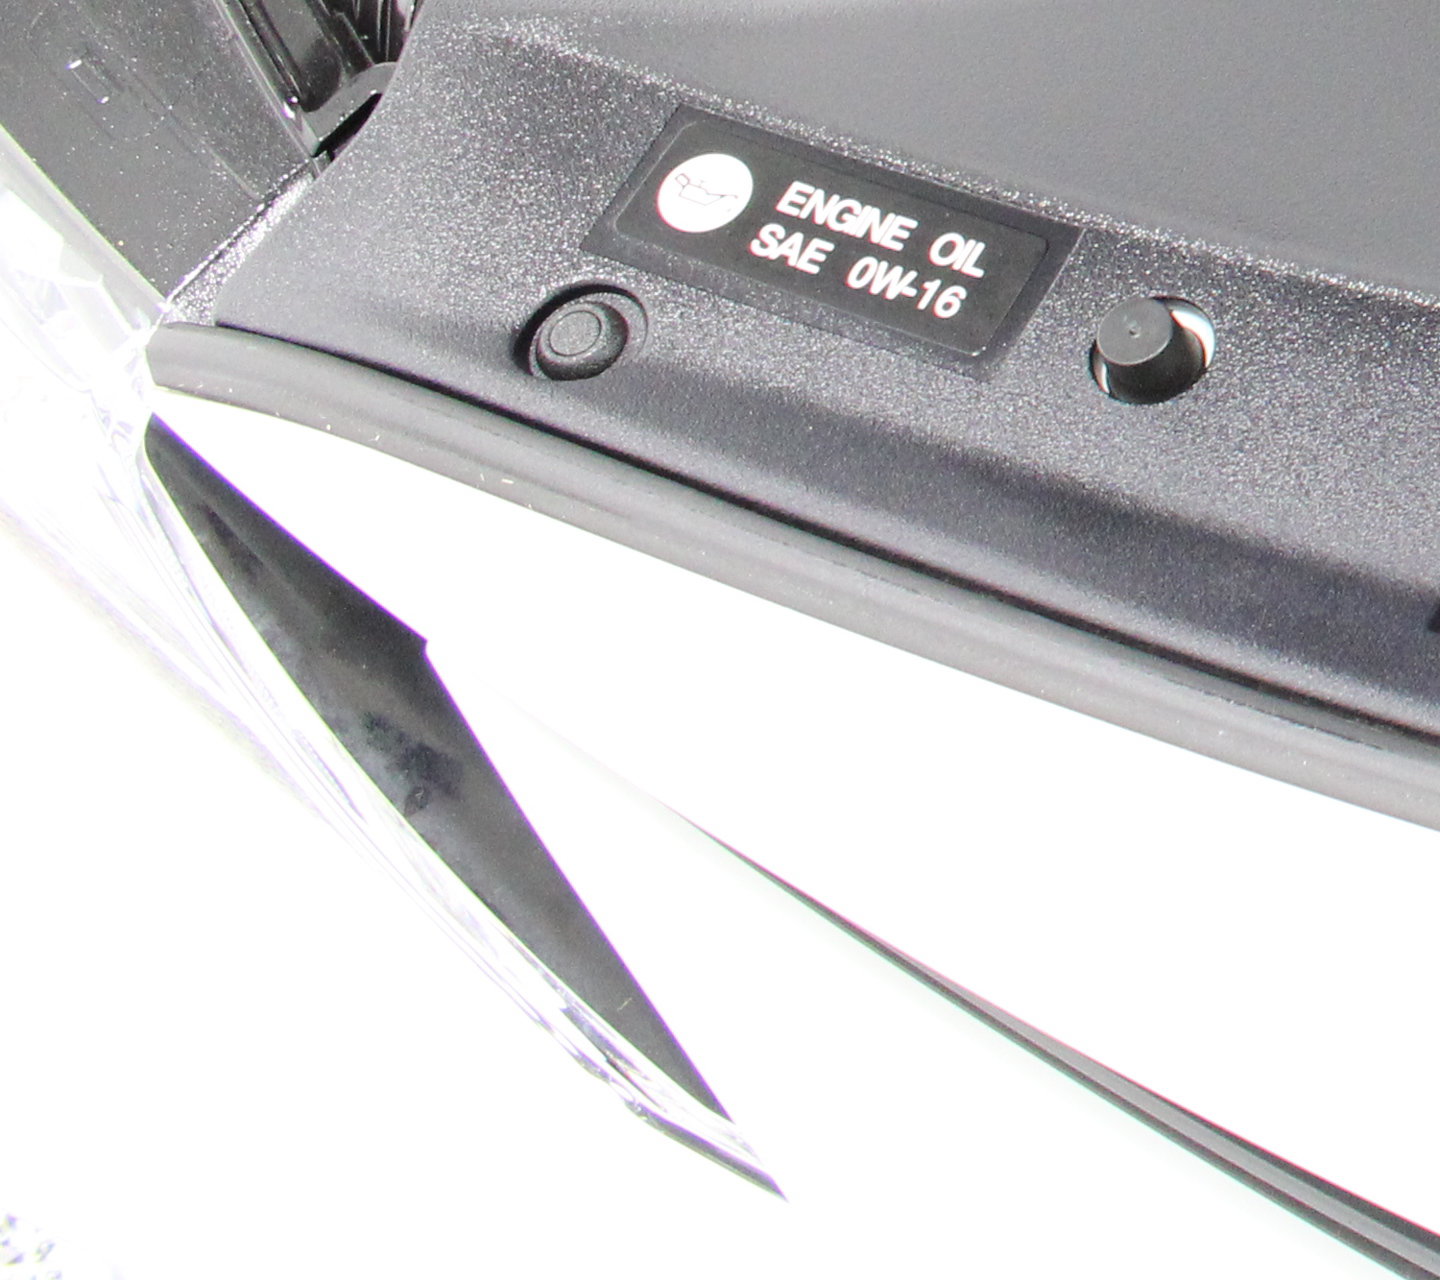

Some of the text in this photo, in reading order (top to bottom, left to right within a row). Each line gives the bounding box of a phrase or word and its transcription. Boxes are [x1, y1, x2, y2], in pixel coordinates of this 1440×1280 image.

[749, 223, 968, 320] SAE 0W-16
[775, 180, 986, 278] ENGINE OIL
